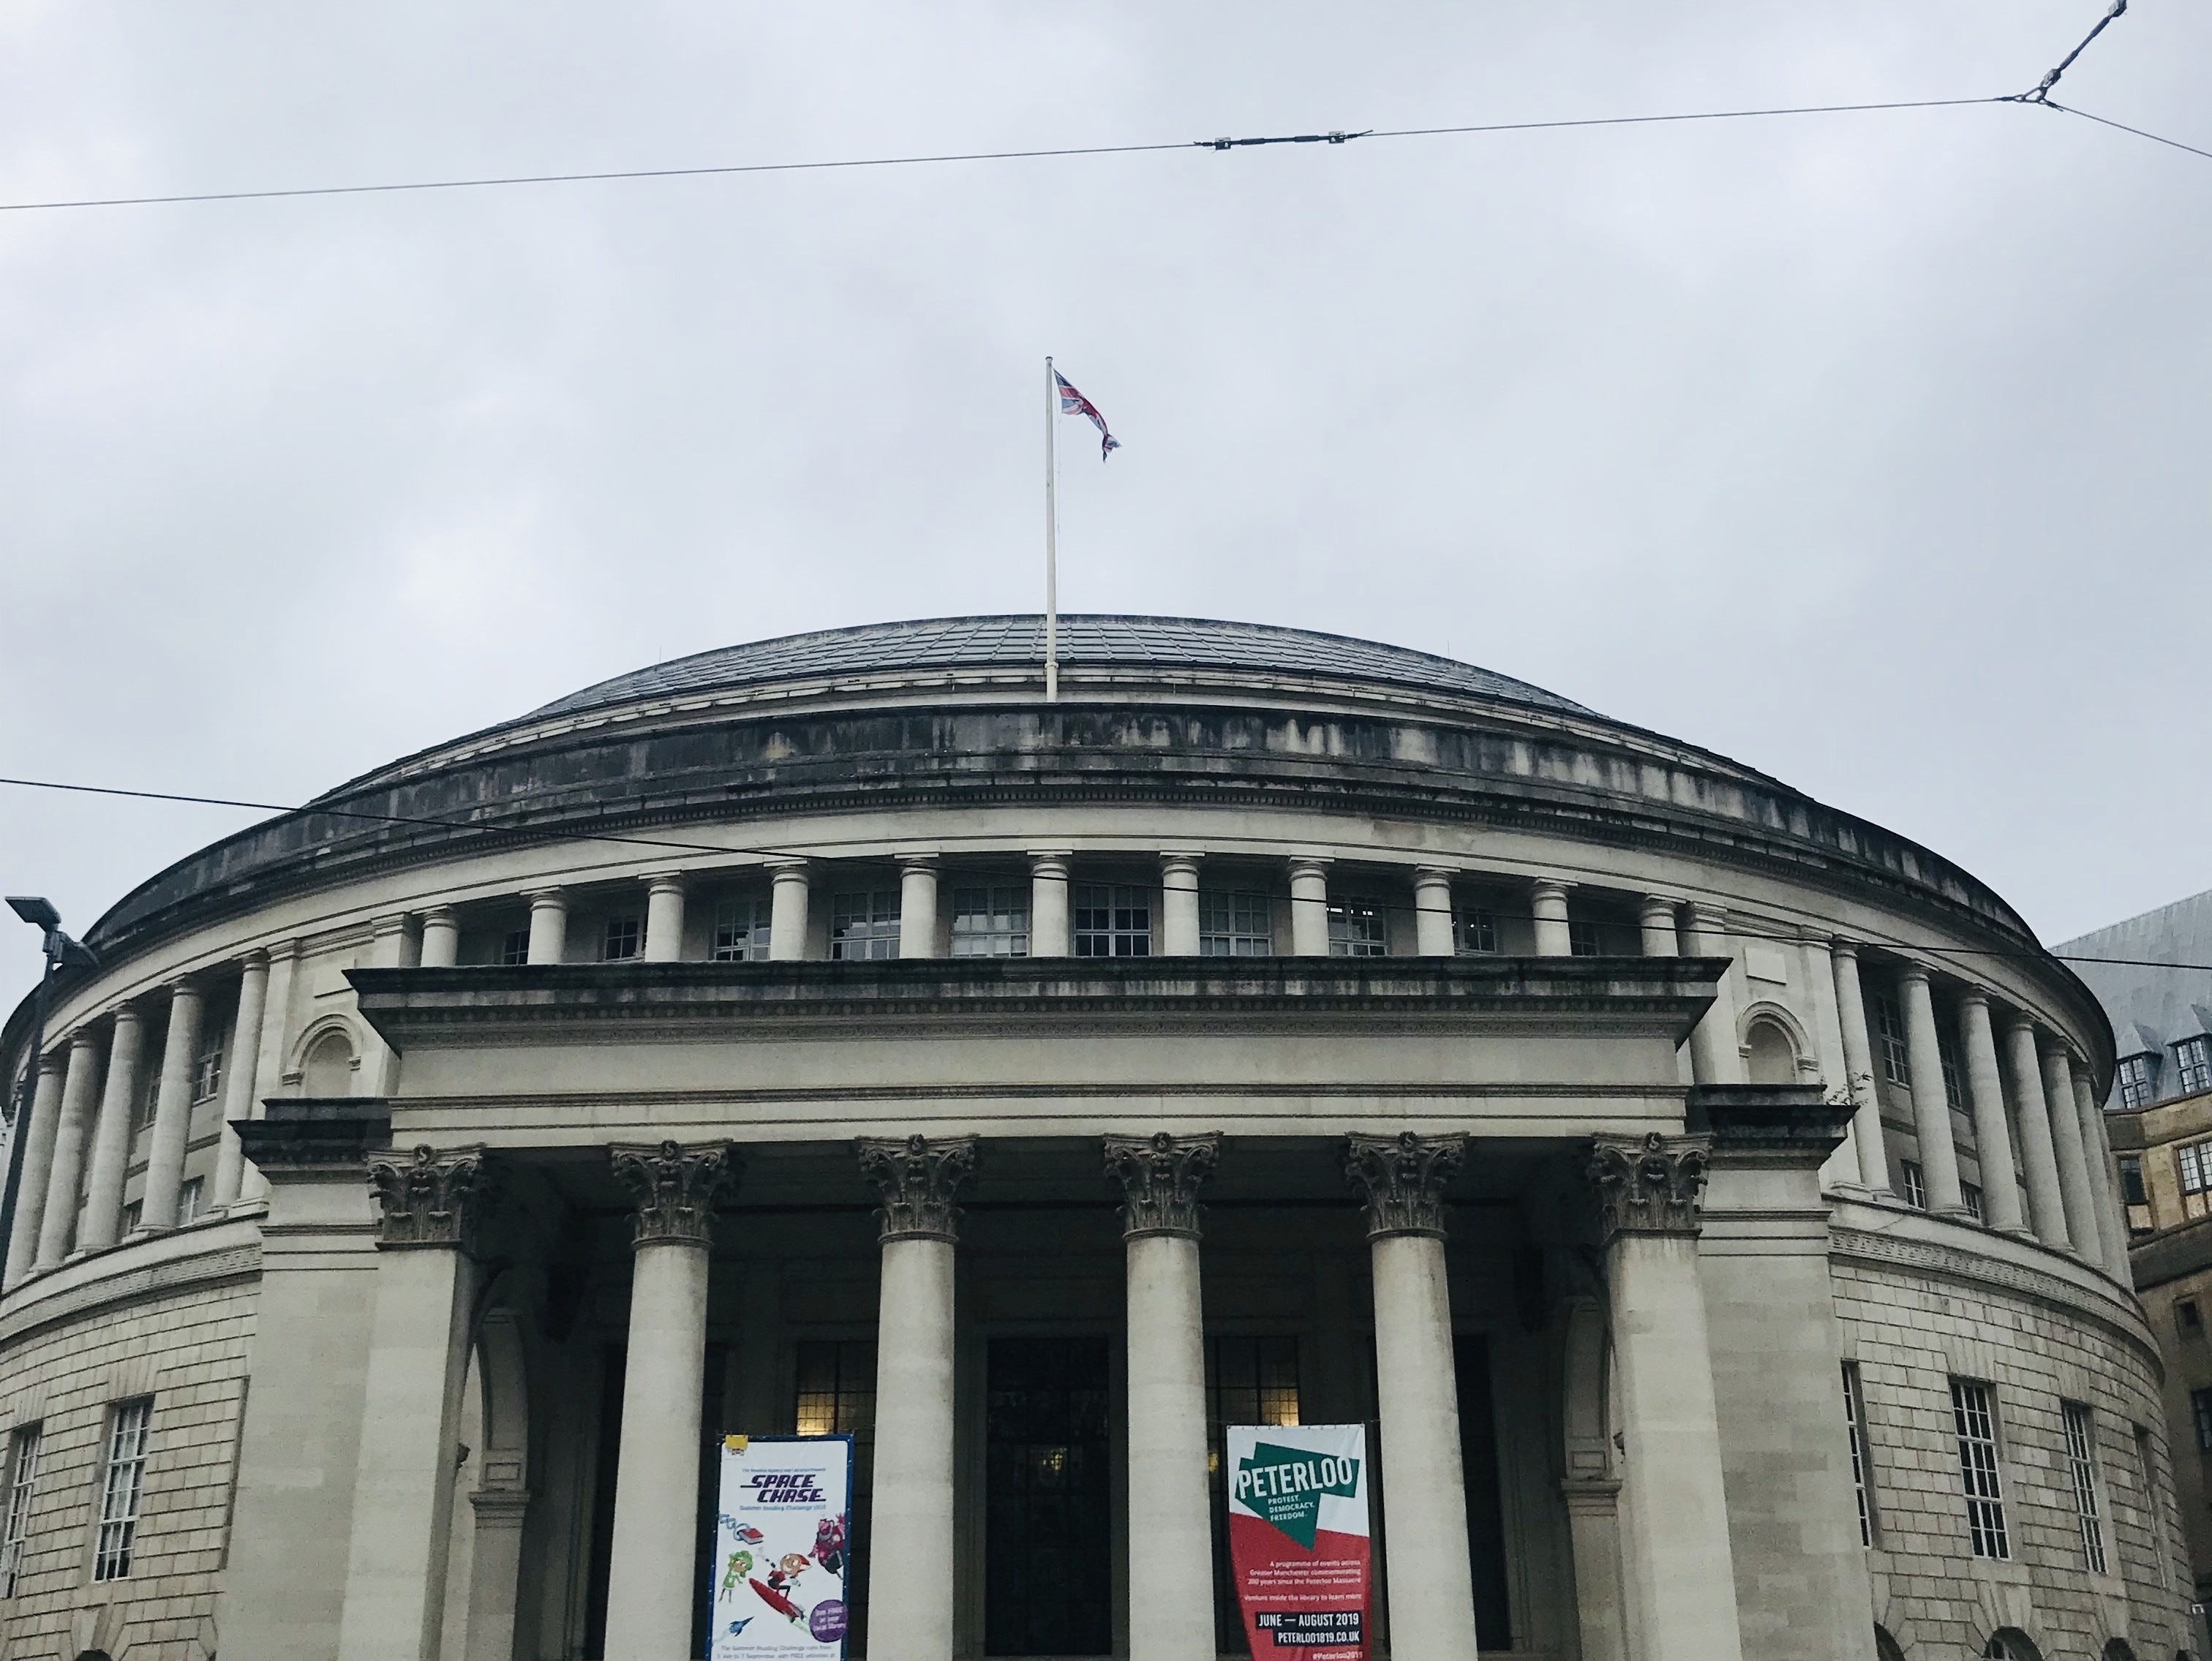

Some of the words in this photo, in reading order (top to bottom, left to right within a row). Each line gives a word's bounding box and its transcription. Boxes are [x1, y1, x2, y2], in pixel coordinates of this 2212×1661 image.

[740, 1474, 816, 1488] SPACE
[1237, 1456, 1353, 1499] PETERLOO
[756, 1488, 827, 1502] CHASE
[1268, 1494, 1301, 1504] PROTEST.
[1269, 1502, 1314, 1513] DEMOCRACY.
[1271, 1511, 1307, 1521] FREEDOM.
[1258, 1613, 1282, 1627] JUNE
[1298, 1613, 1334, 1627] AUGUST
[1336, 1613, 1359, 1626] 2019
[1278, 1630, 1360, 1643] PETERLOO1819.CO.UK
